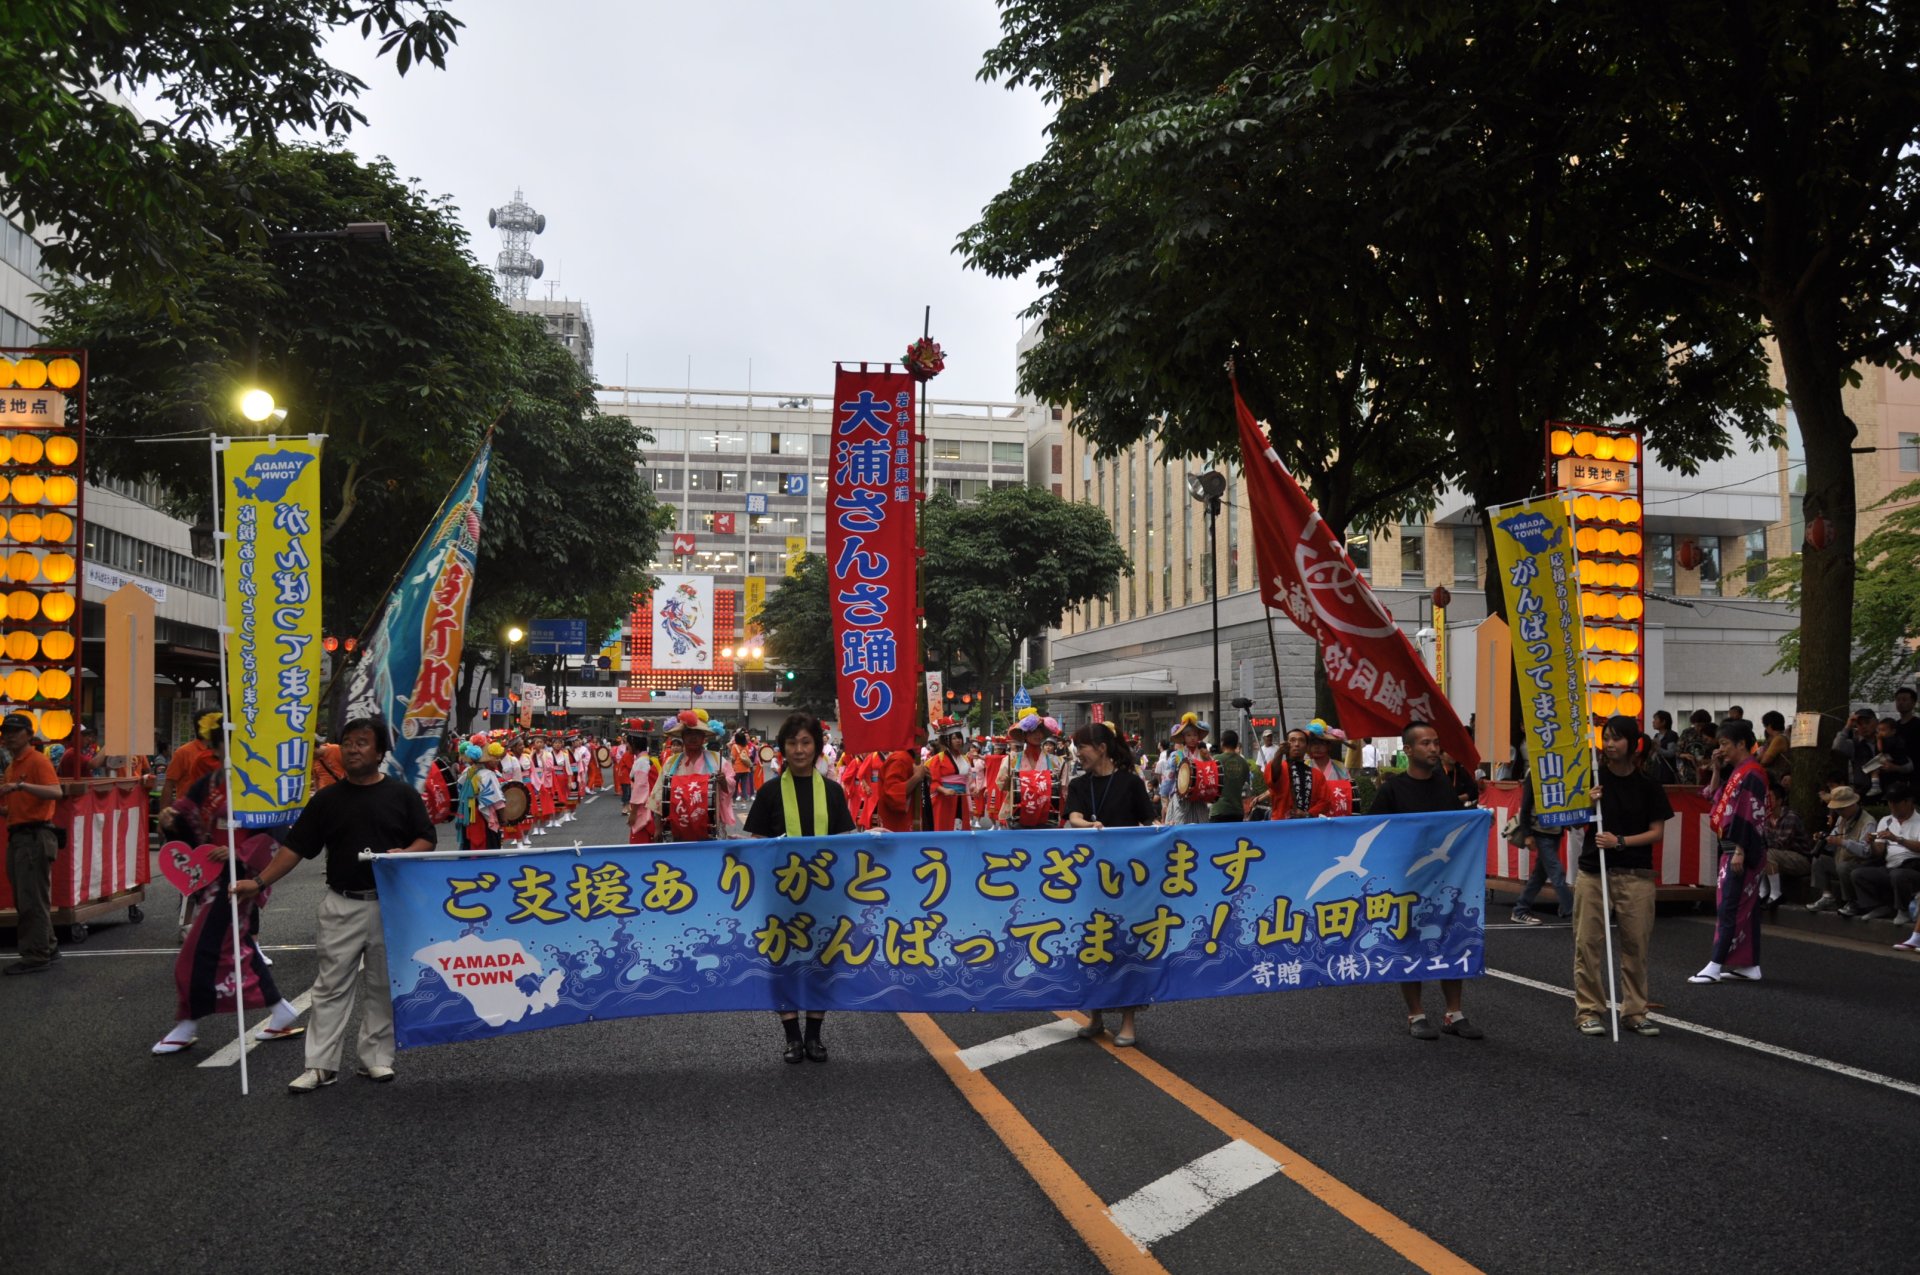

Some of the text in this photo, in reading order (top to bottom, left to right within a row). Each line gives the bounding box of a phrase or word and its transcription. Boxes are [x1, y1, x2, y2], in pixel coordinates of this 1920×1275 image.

[894, 391, 911, 502] 岩手県最東端
[1574, 464, 1625, 482] 出発地点
[1507, 518, 1546, 532] YAMADA
[1514, 527, 1541, 540] TOWN
[834, 390, 897, 722] 大浦さんさ踊り
[688, 781, 703, 806] 大浦
[1333, 787, 1347, 811] 大浦
[674, 786, 689, 828] さんさ
[443, 835, 1265, 924] ご支援ありがとうございます
[437, 952, 525, 971] YAMADA
[452, 969, 514, 987] TOWN
[1252, 960, 1302, 988] 寄贈
